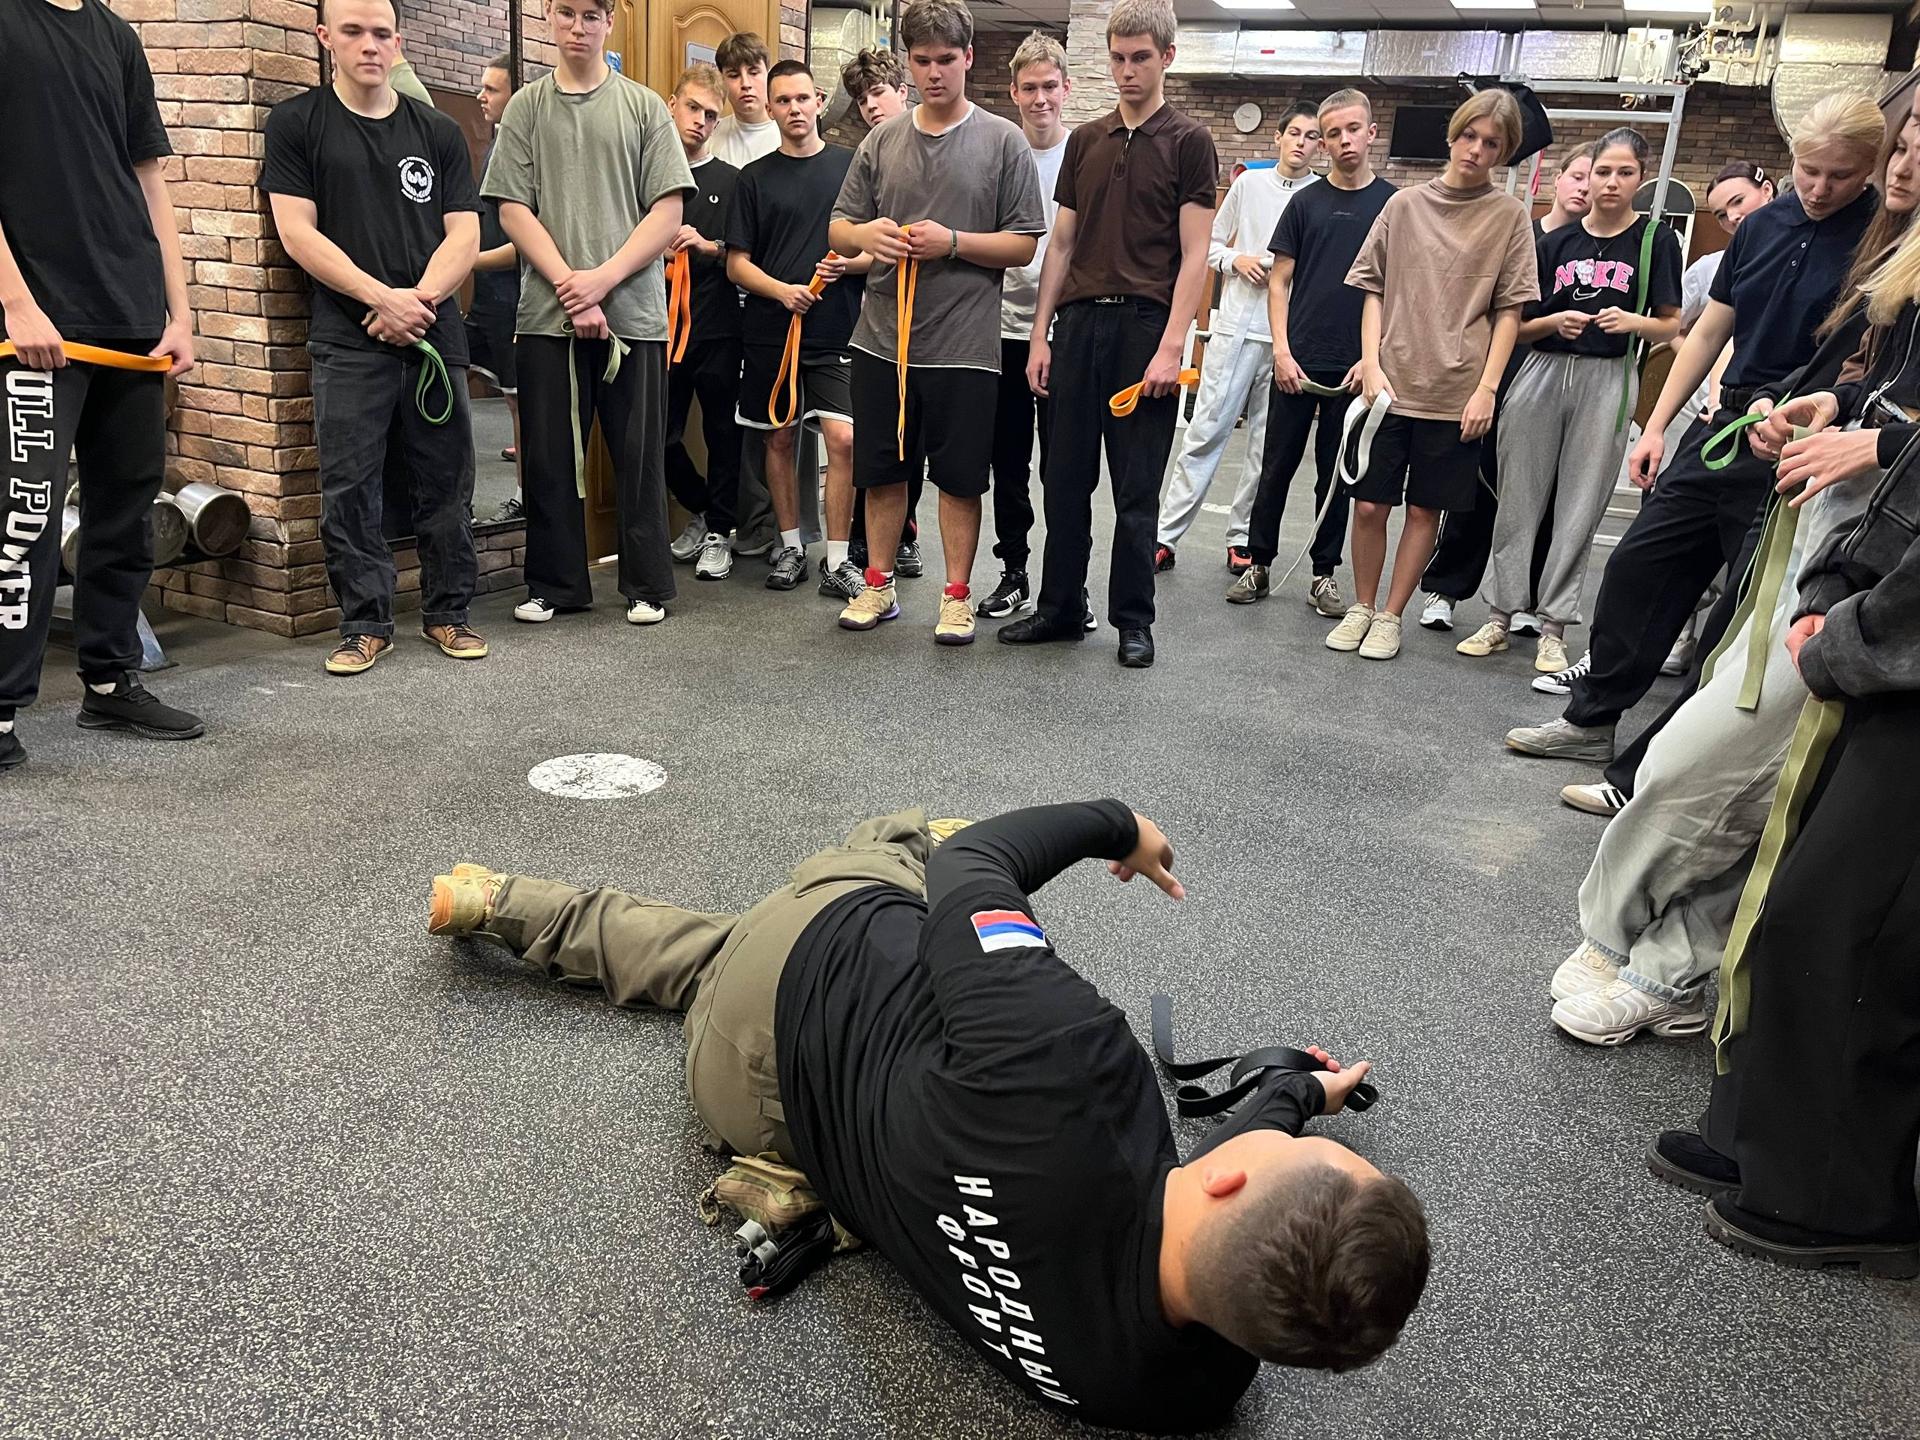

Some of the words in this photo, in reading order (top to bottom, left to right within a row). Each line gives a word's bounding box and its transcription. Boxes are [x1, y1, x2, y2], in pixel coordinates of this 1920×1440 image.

[1553, 258, 1634, 294] NKE
[937, 1214, 1012, 1360] ФРОНТ
[954, 1175, 1079, 1405] НАРОДНЫЙ
